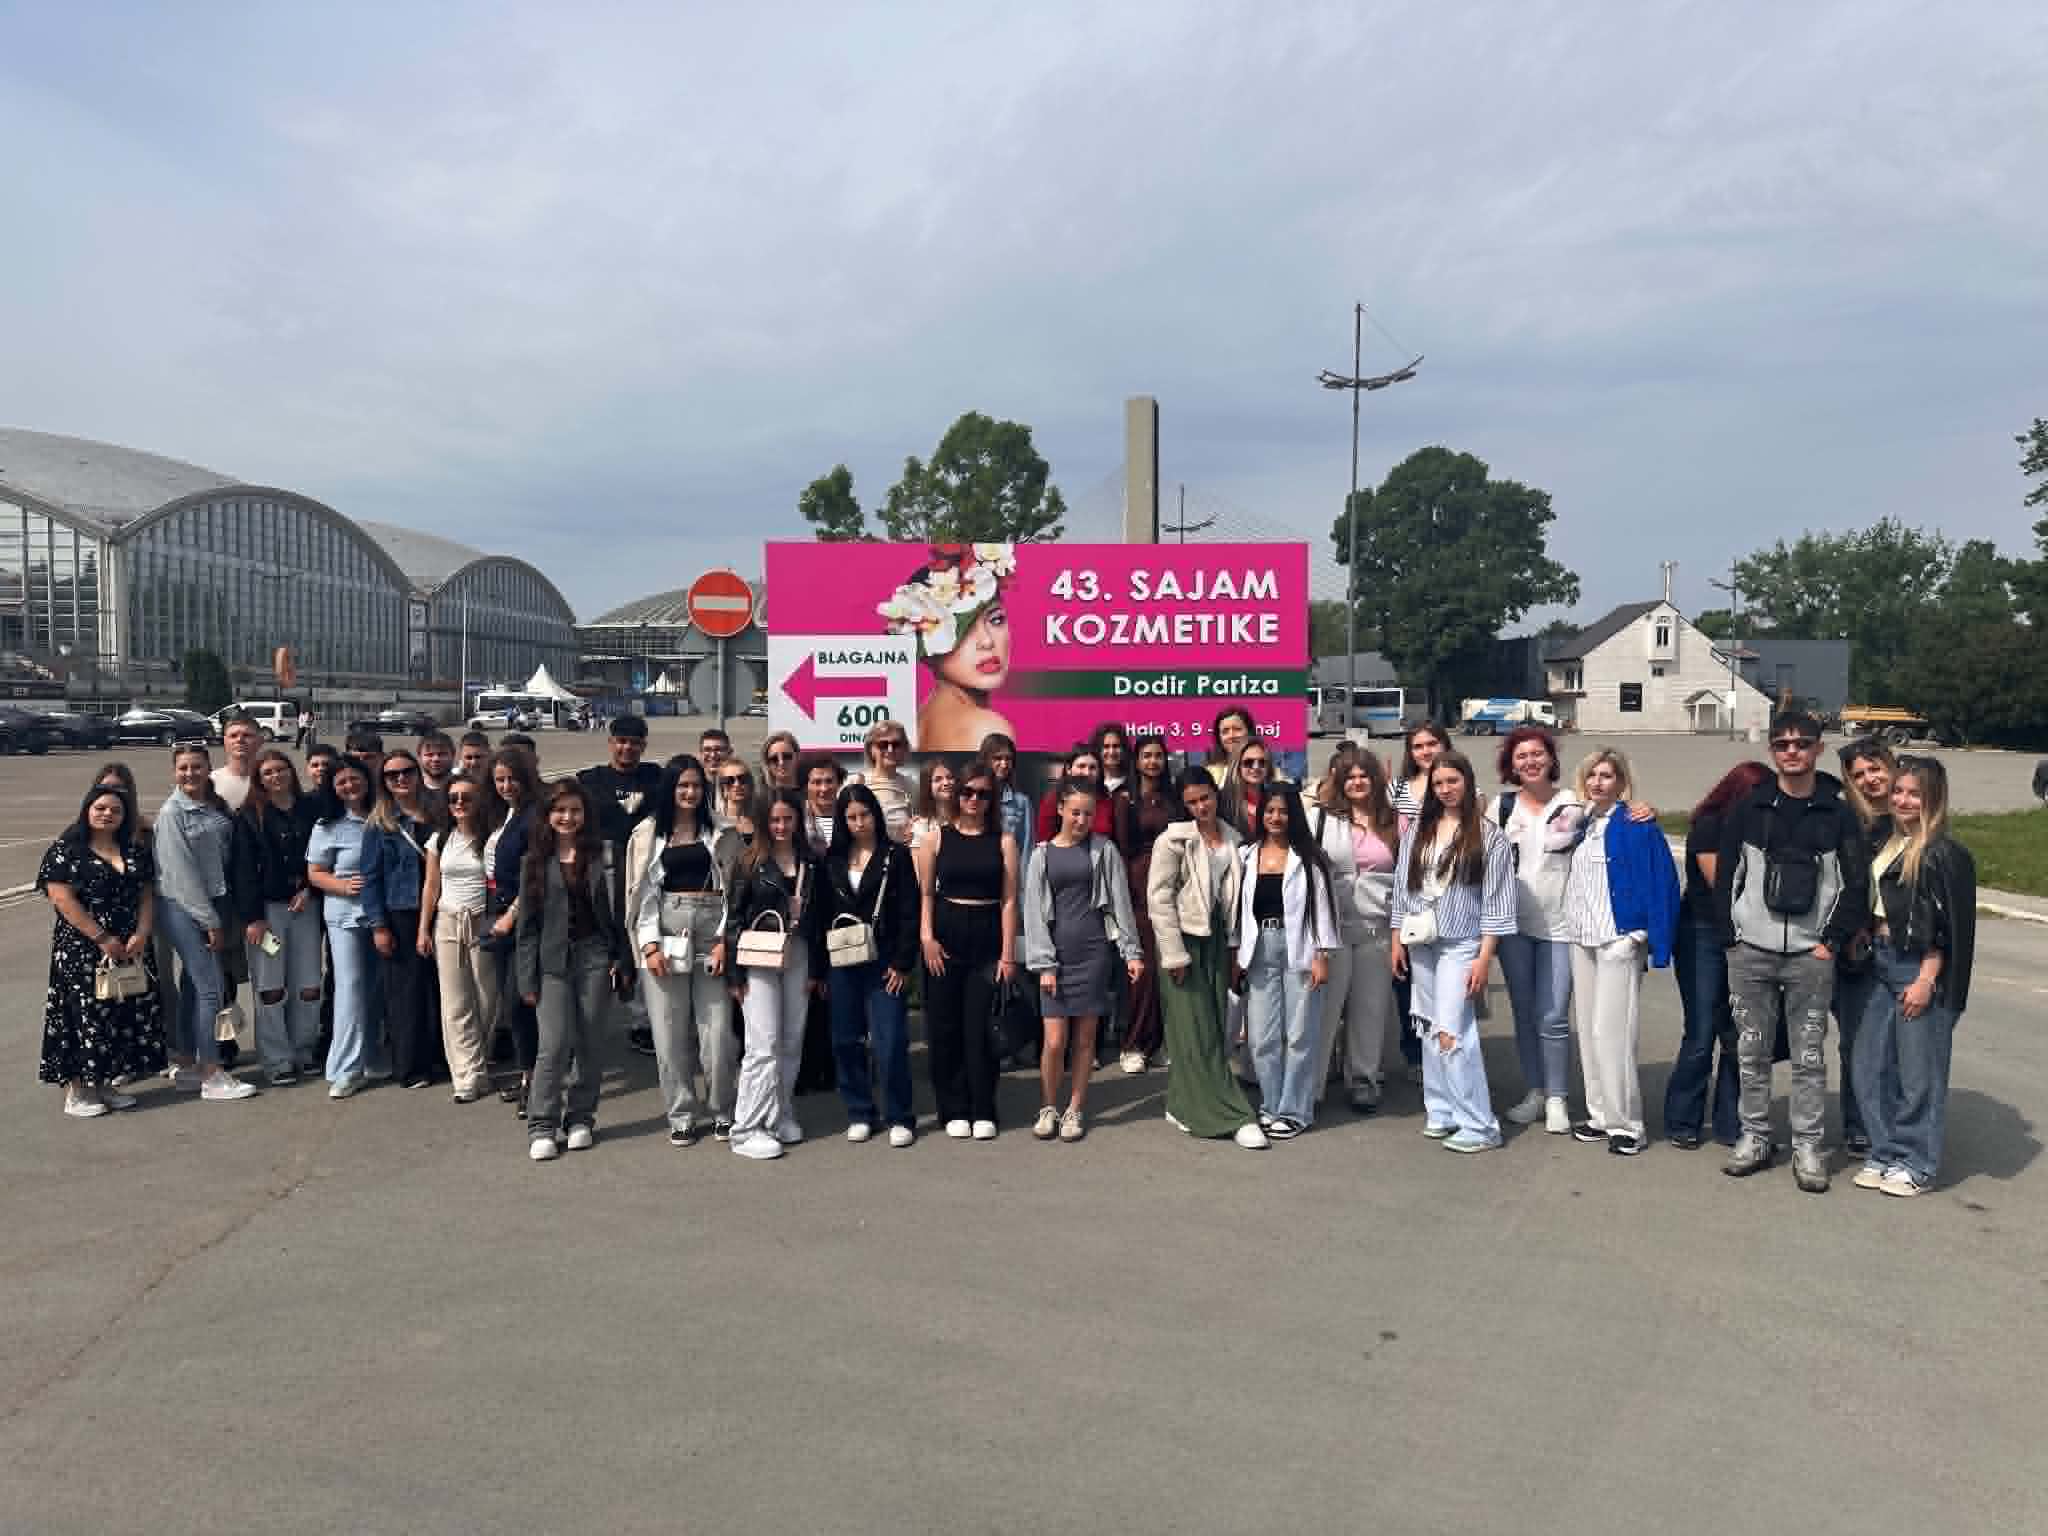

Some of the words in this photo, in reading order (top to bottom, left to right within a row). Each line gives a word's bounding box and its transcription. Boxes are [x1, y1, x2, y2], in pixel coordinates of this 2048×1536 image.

[1050, 568, 1113, 601] 43.
[1129, 568, 1280, 601] SAJAM
[1046, 613, 1280, 645] KOZMETIKE
[817, 650, 909, 665] BLAGAJNA
[1112, 674, 1187, 696] Dodir
[1196, 674, 1279, 695] Pariza
[837, 704, 890, 727] 600
[839, 732, 866, 743] DIN
[1125, 721, 1166, 737] Hala
[1191, 721, 1202, 737] 9
